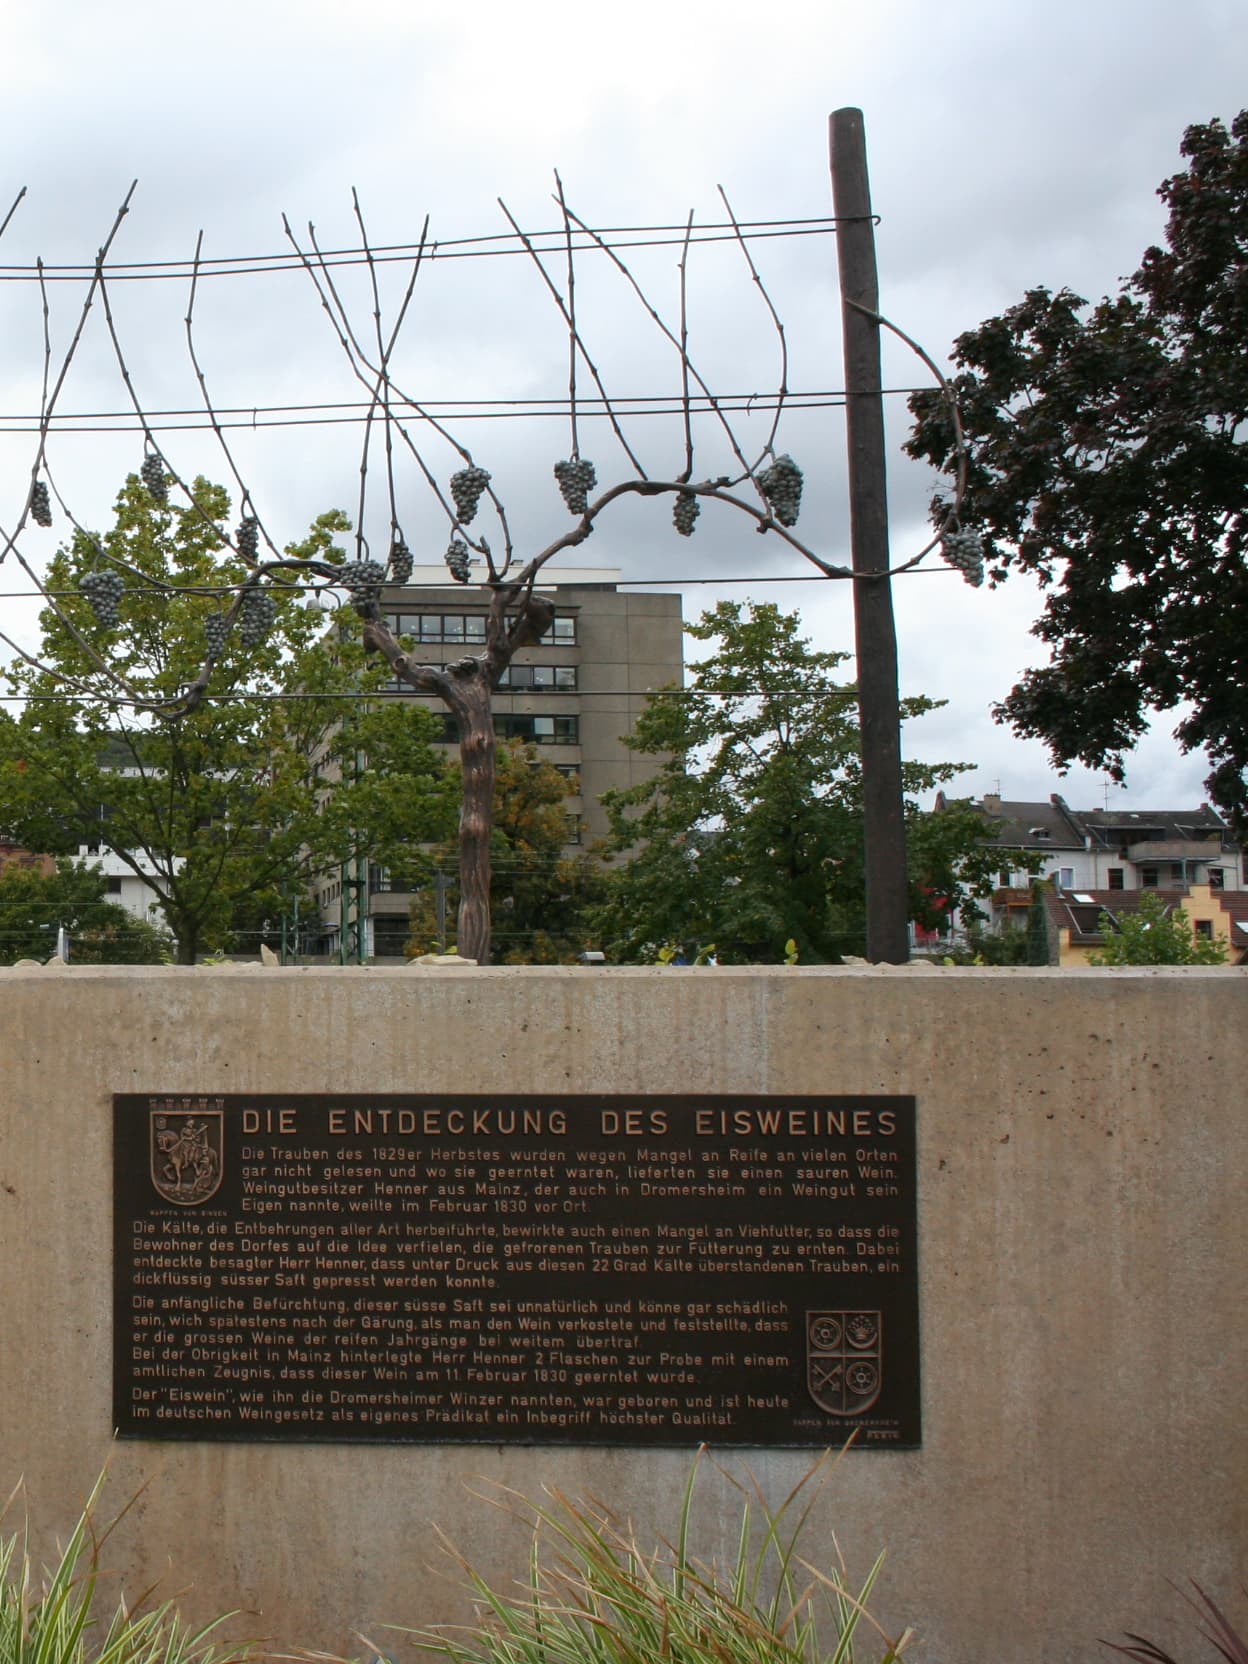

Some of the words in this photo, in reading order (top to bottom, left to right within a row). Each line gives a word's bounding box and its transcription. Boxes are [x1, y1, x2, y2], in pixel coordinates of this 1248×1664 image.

[241, 1108, 297, 1134] DIE
[327, 1108, 567, 1135] ENTDECKUNG
[600, 1108, 668, 1135] DES
[695, 1109, 896, 1136] EISWEINES
[240, 1145, 265, 1160] Die
[269, 1145, 329, 1161] Trauben
[335, 1146, 363, 1161] des
[371, 1146, 423, 1161] 1829er
[430, 1146, 501, 1161] Herbstes
[509, 1148, 566, 1161] wurden
[575, 1150, 627, 1165] wegen
[636, 1147, 692, 1165] Mangel
[700, 1150, 720, 1162] an
[728, 1147, 769, 1162] Reife
[800, 1147, 847, 1162] vielen
[854, 1147, 898, 1162] Orten
[241, 1166, 267, 1180] gar
[273, 1163, 312, 1177] nicht
[322, 1163, 382, 1181] gelesen
[424, 1166, 447, 1178] wo
[453, 1163, 476, 1178] sie
[487, 1164, 555, 1182] geerntet
[564, 1167, 619, 1182] waren,
[627, 1165, 696, 1179] lieferten
[739, 1168, 783, 1179] einen
[795, 1167, 849, 1180] sauren
[241, 1180, 364, 1199] Weingutbesitzer
[373, 1181, 429, 1196] Henner
[436, 1184, 465, 1196] aus
[474, 1181, 528, 1198] Mainz,
[533, 1182, 561, 1196] der
[567, 1182, 607, 1197] auch
[614, 1182, 630, 1196] in
[639, 1181, 745, 1197] Dromersheim
[757, 1182, 782, 1197] ein
[790, 1182, 856, 1200] Weingut
[865, 1185, 898, 1197] sein
[241, 1196, 283, 1215] Eigen
[288, 1197, 345, 1213] nannte,
[347, 1198, 393, 1212] weilte
[400, 1198, 420, 1212] im
[428, 1198, 488, 1213] Februar
[493, 1198, 527, 1213] 1830
[533, 1201, 558, 1213] vor
[161, 1220, 204, 1237] Kälte,
[233, 1221, 335, 1239] Entbehrungen
[339, 1222, 373, 1236] aller
[376, 1222, 400, 1236] Art
[501, 1222, 566, 1237] bewirkte
[569, 1223, 606, 1238] auch
[610, 1224, 651, 1238] einen
[656, 1223, 709, 1241] Mangel
[737, 1223, 812, 1240] Viehfutter,
[815, 1227, 833, 1238] so
[837, 1224, 872, 1239] dass
[132, 1237, 204, 1252] Bewohner
[240, 1237, 289, 1253] Dorfes
[296, 1238, 321, 1253] auf
[356, 1239, 388, 1254] Idee
[395, 1239, 467, 1256] verfielen,
[502, 1240, 584, 1258] gefrorenen
[588, 1240, 649, 1256] Trauben
[655, 1244, 682, 1256] zur
[771, 1244, 790, 1256] zu
[855, 1241, 899, 1256] Dabei
[132, 1253, 203, 1269] entdeckte
[208, 1254, 275, 1272] besagter
[278, 1255, 311, 1270] Herr
[314, 1255, 368, 1273] Henner,
[370, 1256, 406, 1271] dass
[410, 1256, 451, 1271] unter
[454, 1256, 499, 1272] Druck
[537, 1257, 585, 1272] diesen
[591, 1257, 609, 1272] 22
[612, 1257, 647, 1272] Grad
[697, 1258, 804, 1273] überstandenen
[219, 1273, 270, 1286] süsser
[273, 1272, 306, 1287] Saft
[311, 1272, 376, 1291] gepresst
[382, 1273, 438, 1288] werden
[160, 1295, 245, 1313] anfängliche
[251, 1295, 350, 1315] Befürchtung,
[352, 1297, 399, 1312] dieser
[403, 1300, 447, 1312] süsse
[452, 1297, 484, 1313] Saft
[488, 1298, 511, 1313] sei
[515, 1298, 599, 1314] unnatürlich
[637, 1299, 681, 1314] könne
[715, 1299, 788, 1315] schädlich
[132, 1312, 166, 1329] sein,
[168, 1312, 203, 1327] wich
[208, 1313, 288, 1330] spätestens
[291, 1314, 327, 1329] nach
[420, 1315, 443, 1330] als
[448, 1318, 481, 1331] man
[486, 1316, 513, 1331] den
[516, 1316, 552, 1331] Wein
[556, 1316, 634, 1332] verkostete
[754, 1317, 788, 1332] dass
[131, 1331, 148, 1343] er
[183, 1332, 243, 1347] grossen
[250, 1330, 295, 1345] Weine
[333, 1331, 379, 1346] reifen
[386, 1332, 468, 1350] Jahrgänge
[478, 1332, 501, 1347] bei
[508, 1334, 565, 1348] weitem
[131, 1346, 155, 1360] Bei
[190, 1347, 259, 1365] Obrigkeit
[286, 1348, 332, 1363] Mainz
[339, 1348, 423, 1367] hinterlegte
[431, 1349, 466, 1364] Herr
[472, 1350, 526, 1365] Henner
[534, 1350, 544, 1366] 2
[548, 1350, 619, 1366] Flaschen
[659, 1351, 703, 1366] Probe
[710, 1351, 735, 1366] mit
[742, 1355, 789, 1367] einem
[131, 1363, 206, 1378] amtlichen
[212, 1364, 275, 1383] Zeugnis,
[279, 1365, 316, 1380] dass
[320, 1366, 368, 1381] dieser
[372, 1366, 408, 1380] Wein
[414, 1369, 439, 1382] am
[466, 1367, 528, 1383] Februar
[533, 1367, 567, 1383] 1830
[573, 1368, 639, 1386] geerntet
[131, 1387, 158, 1401] Der
[238, 1389, 265, 1403] wie
[271, 1389, 294, 1403] ihn
[329, 1390, 444, 1405] Dromersheimer
[448, 1391, 504, 1406] Winzer
[509, 1392, 577, 1410] nannten,
[581, 1395, 613, 1407] war
[617, 1393, 679, 1411] geboren
[720, 1393, 740, 1408] ist
[746, 1393, 789, 1409] heute
[155, 1404, 232, 1420] deutschen
[237, 1405, 324, 1424] Weingesetz
[359, 1410, 419, 1425] eigenes
[525, 1409, 591, 1427] Inbegriff
